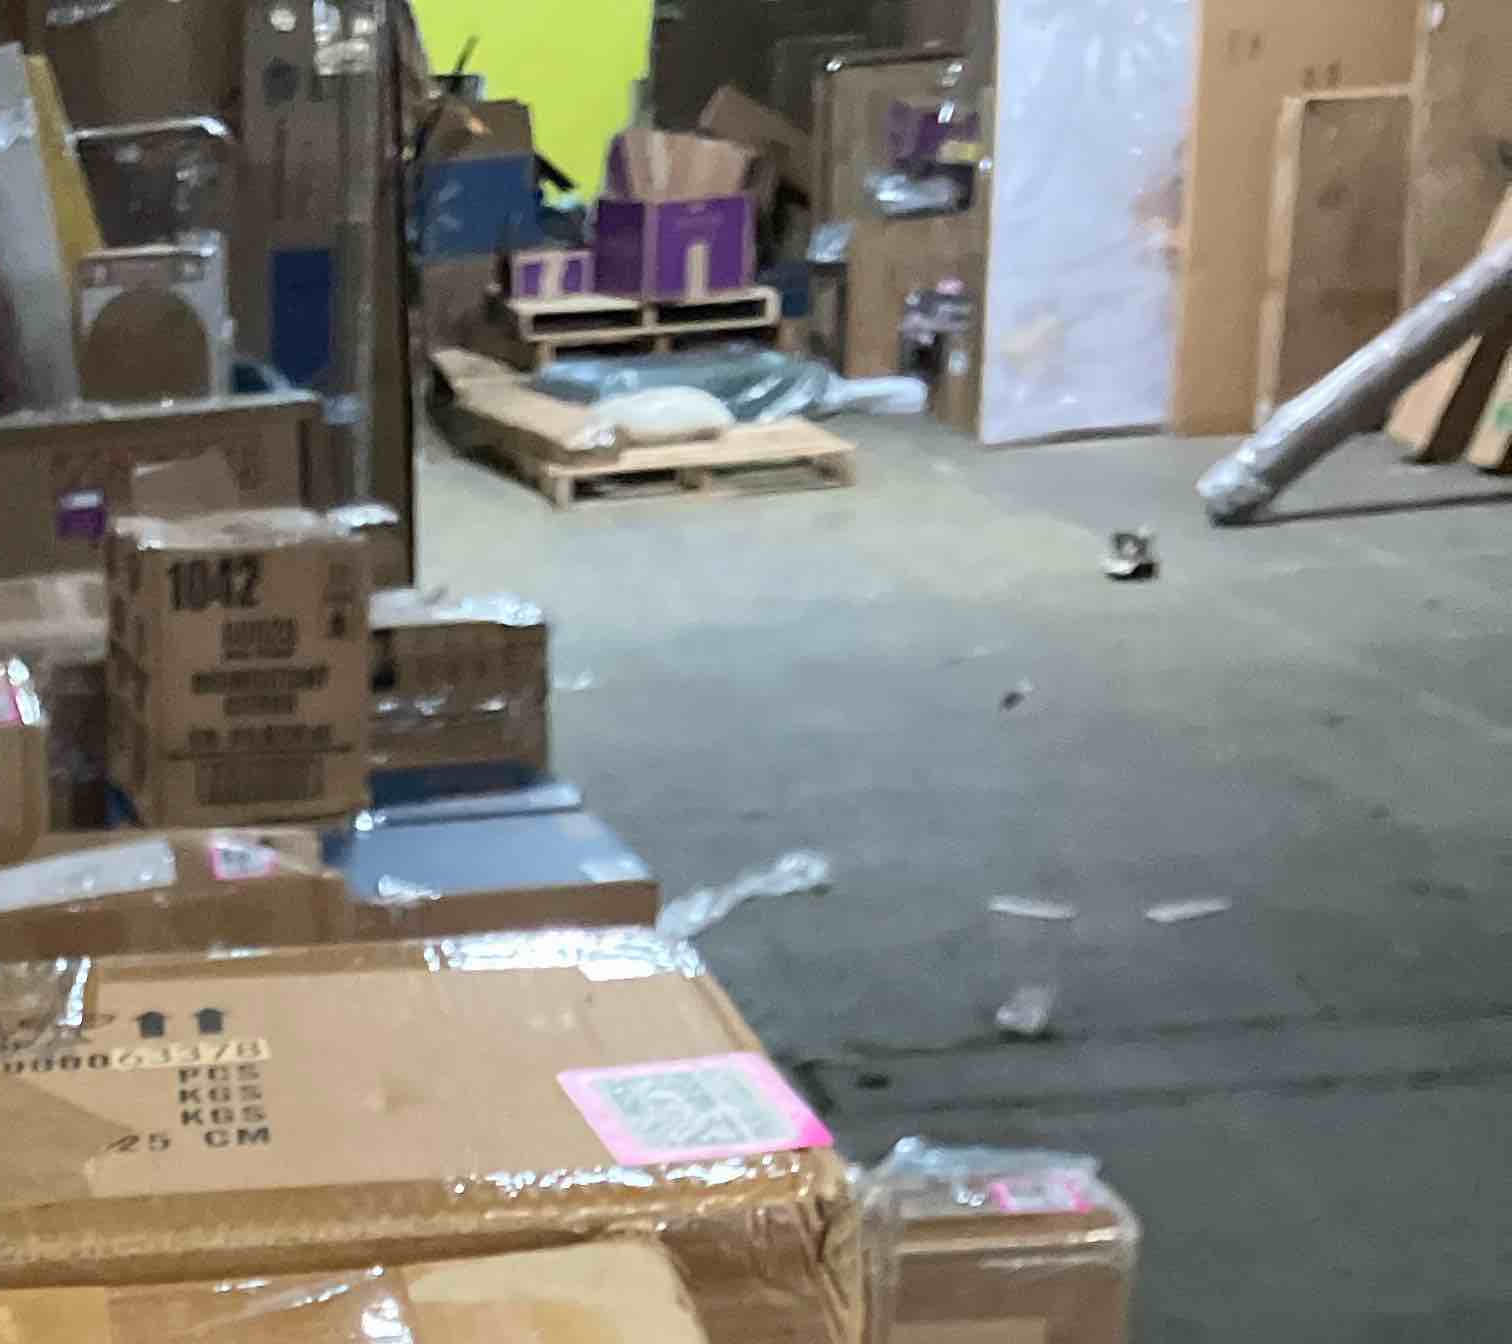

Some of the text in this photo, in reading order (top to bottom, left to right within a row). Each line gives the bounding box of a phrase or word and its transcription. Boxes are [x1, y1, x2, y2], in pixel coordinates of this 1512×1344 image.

[178, 1085, 262, 1103] KGS
[181, 1106, 265, 1125] KGS
[203, 1127, 271, 1147] CM
